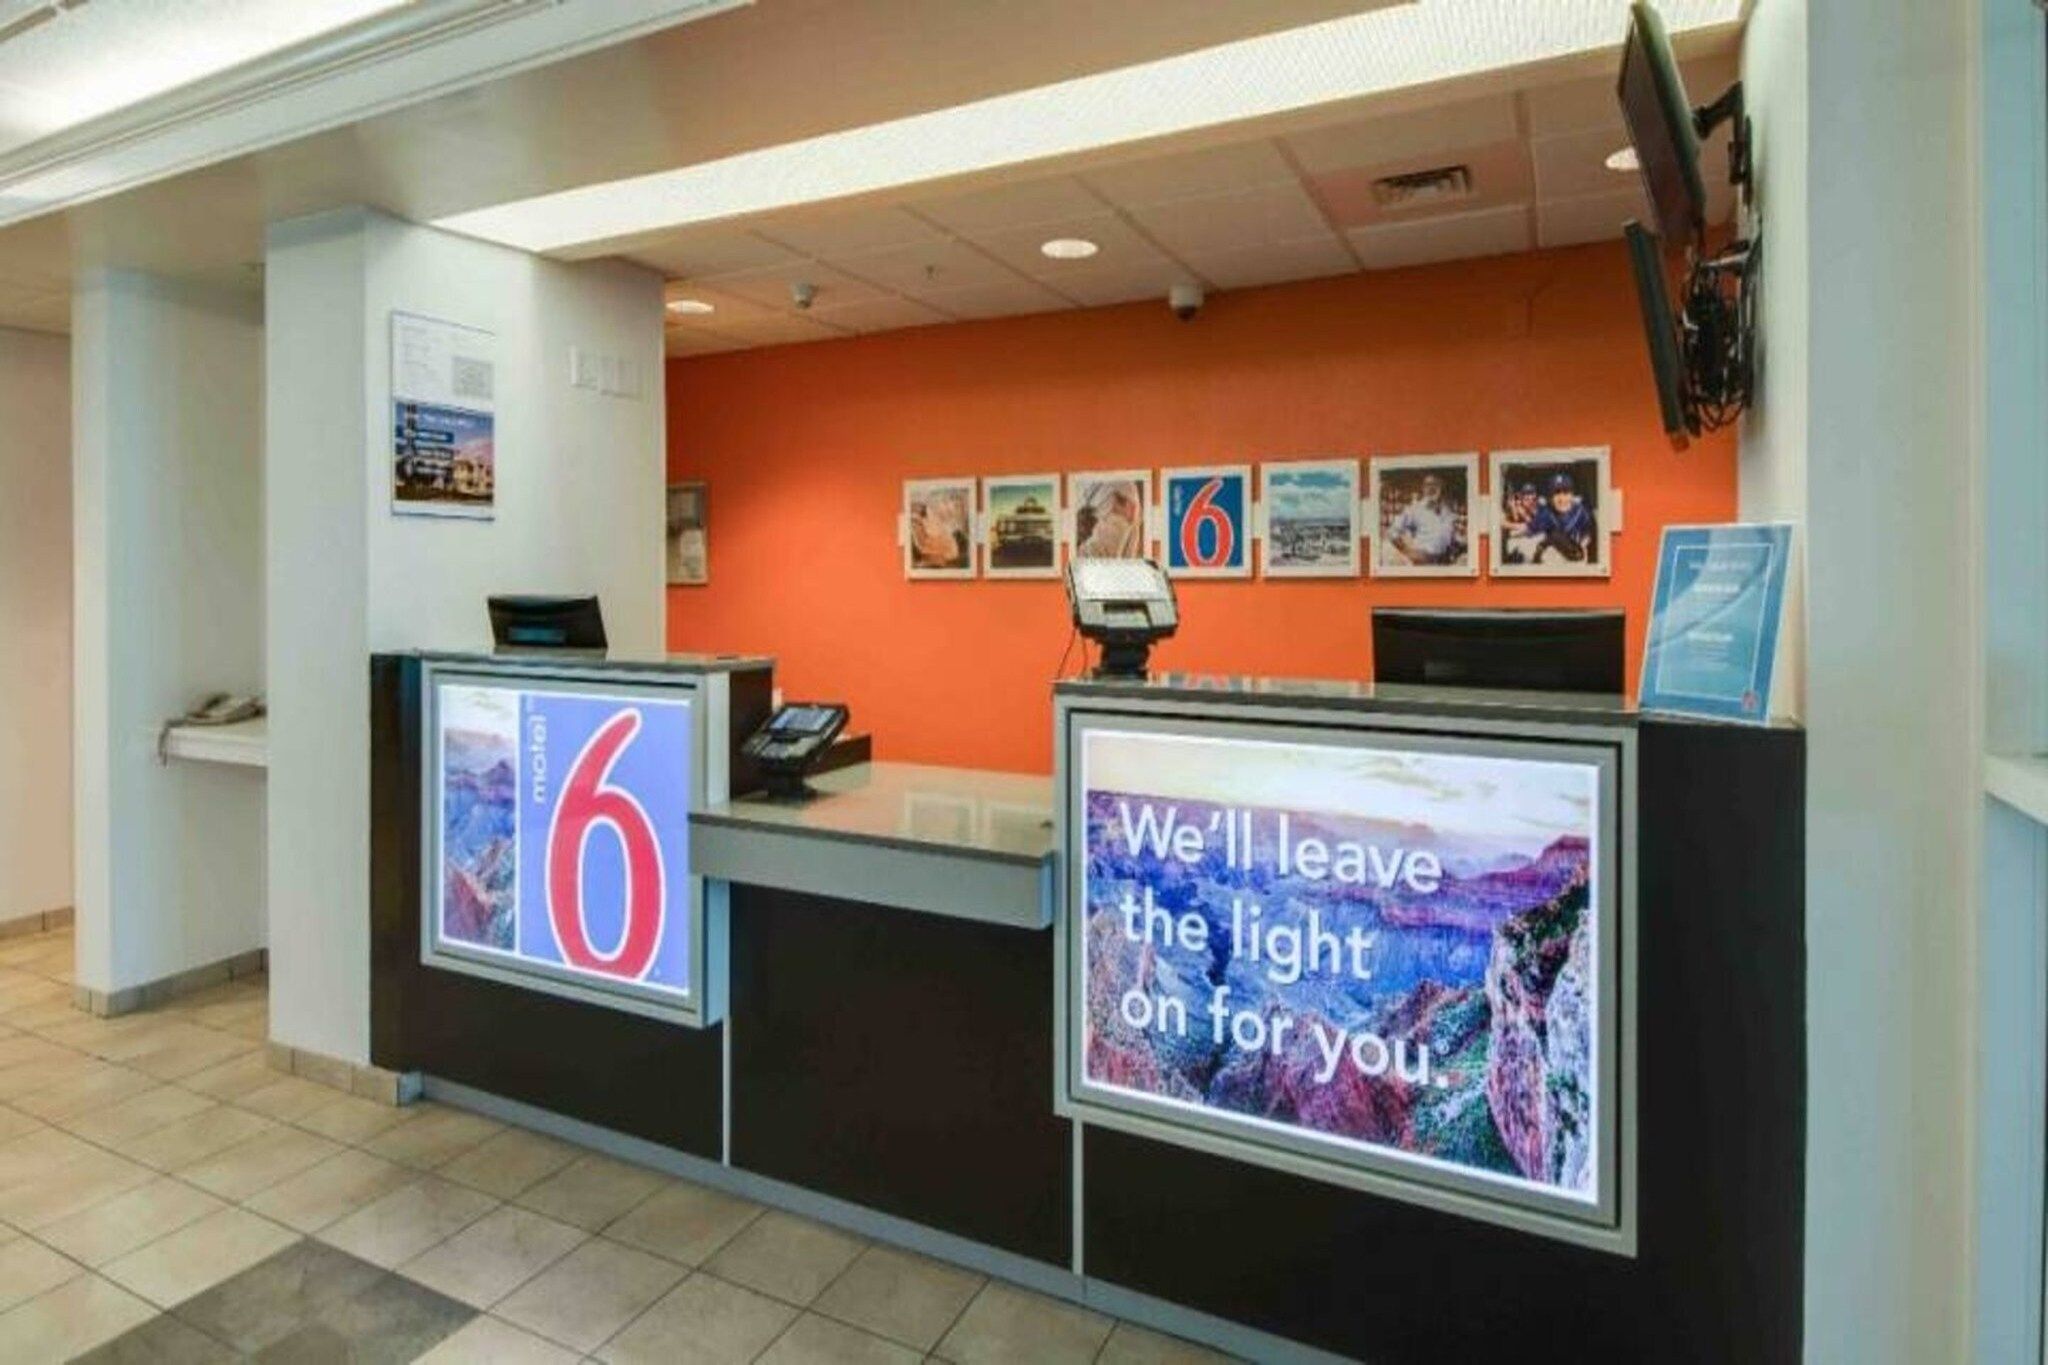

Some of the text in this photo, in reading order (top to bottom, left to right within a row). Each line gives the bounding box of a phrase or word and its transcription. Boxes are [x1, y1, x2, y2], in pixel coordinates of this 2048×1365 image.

[1181, 478, 1234, 567] 6
[528, 715, 547, 804] motel
[545, 707, 667, 983] 6
[1120, 801, 1442, 893] We'll leave
[1119, 887, 1376, 984] the light
[1121, 990, 1187, 1037] on
[1208, 985, 1293, 1055] for
